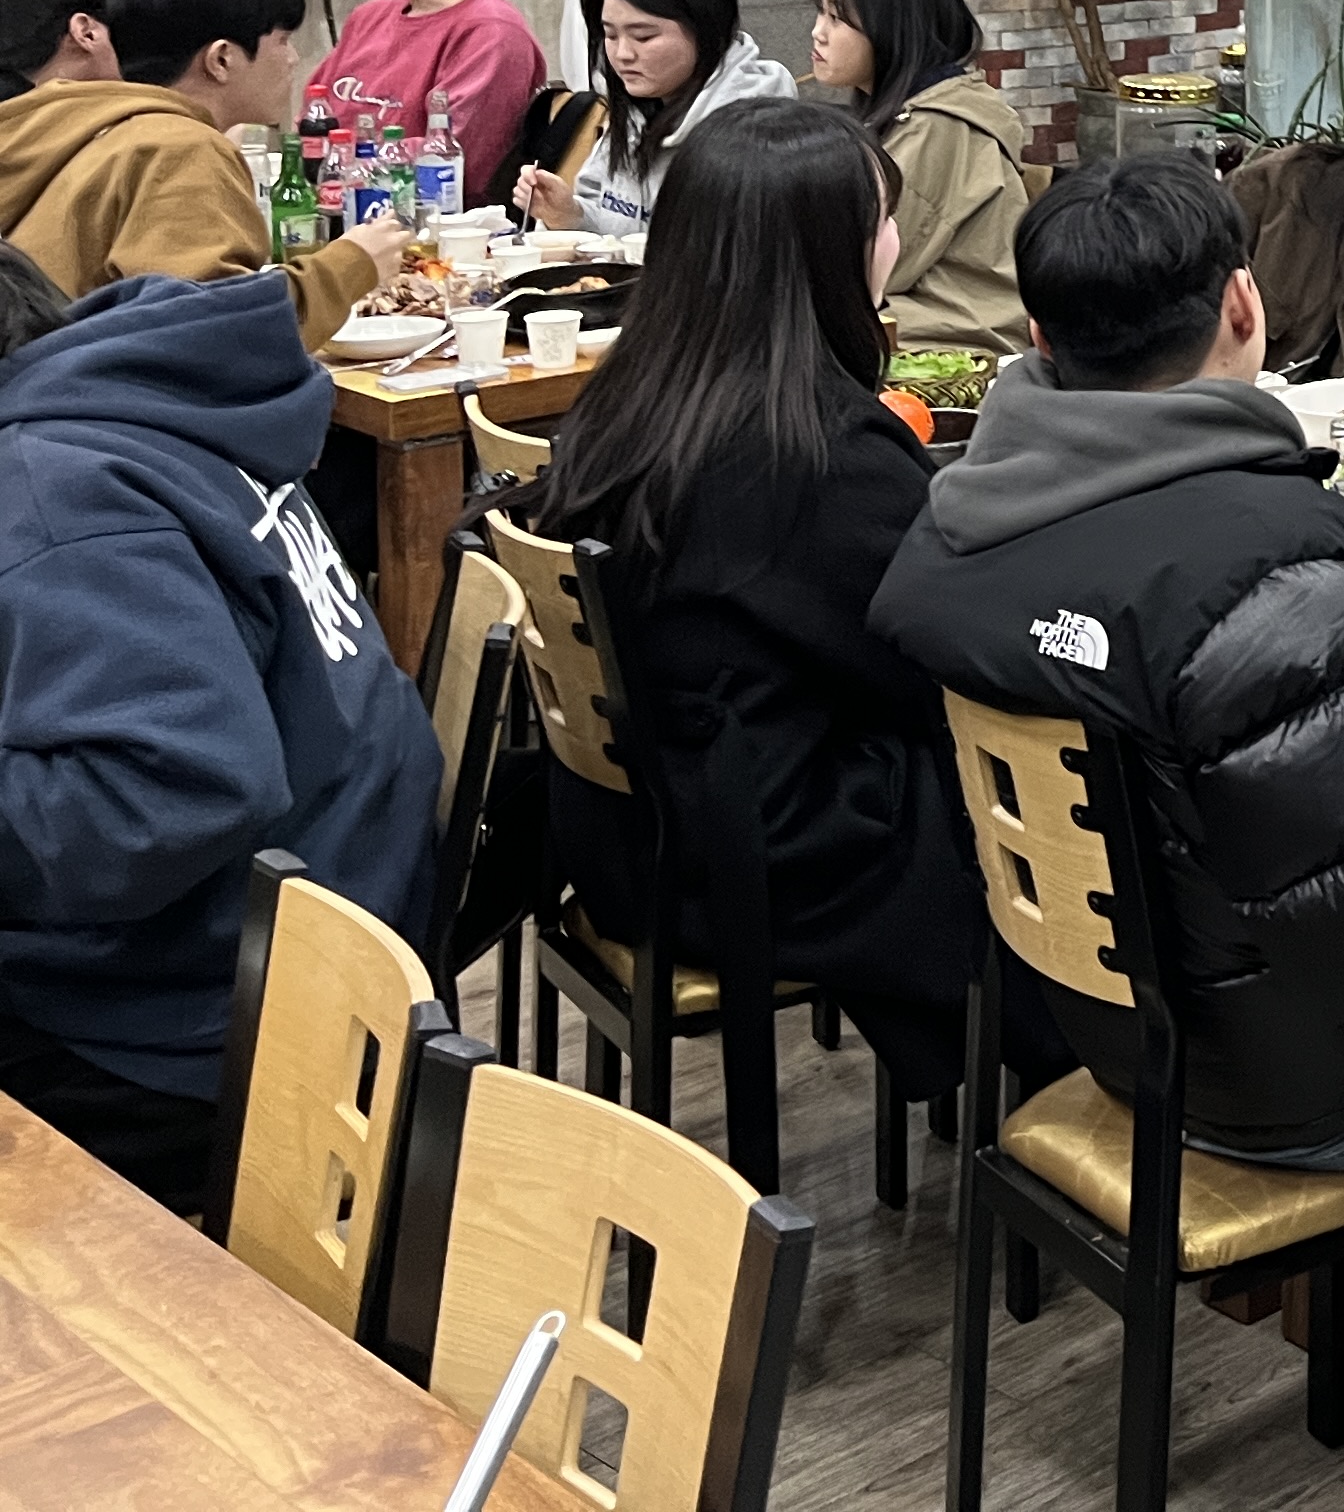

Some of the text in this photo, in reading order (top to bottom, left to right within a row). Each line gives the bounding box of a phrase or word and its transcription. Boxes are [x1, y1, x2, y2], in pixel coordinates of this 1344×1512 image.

[1057, 609, 1086, 630] THE
[1029, 618, 1080, 646] NORTH
[1038, 641, 1077, 663] FACE
